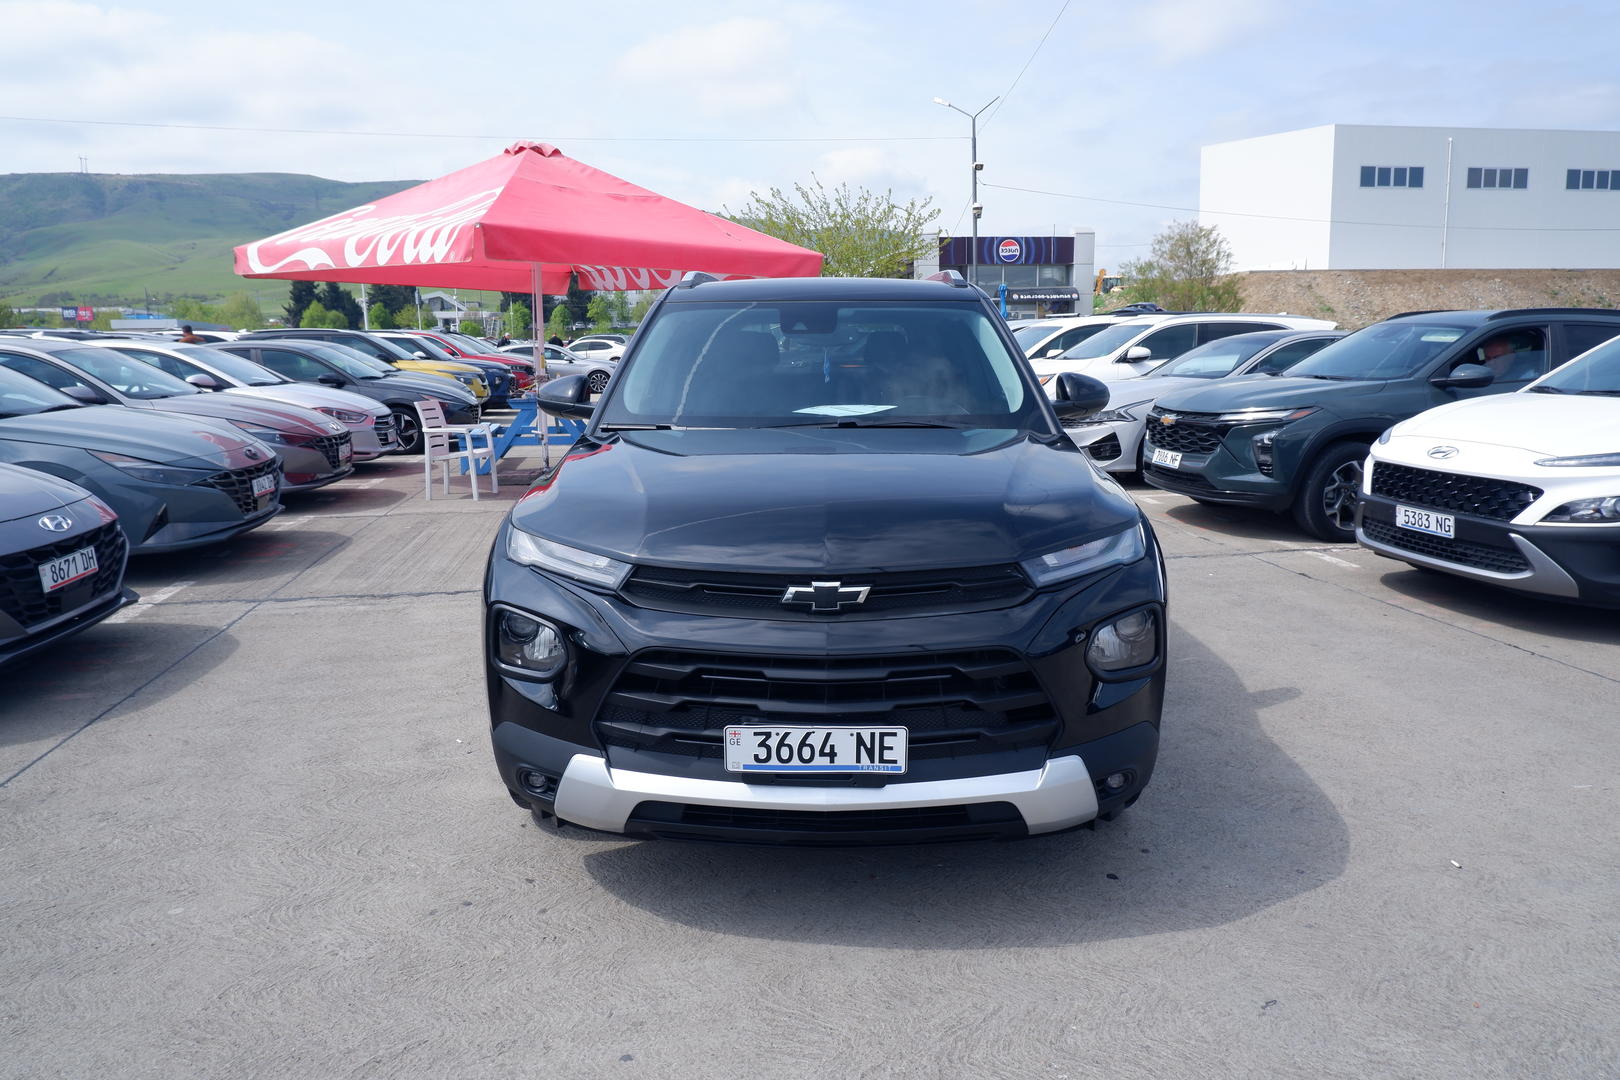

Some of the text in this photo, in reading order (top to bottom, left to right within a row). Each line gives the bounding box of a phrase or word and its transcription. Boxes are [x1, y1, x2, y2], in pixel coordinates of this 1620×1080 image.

[1404, 509, 1452, 533] 5383 NG
[50, 549, 96, 583] 8671 DH
[729, 738, 741, 746] GE
[753, 731, 898, 765] 3664 NE
